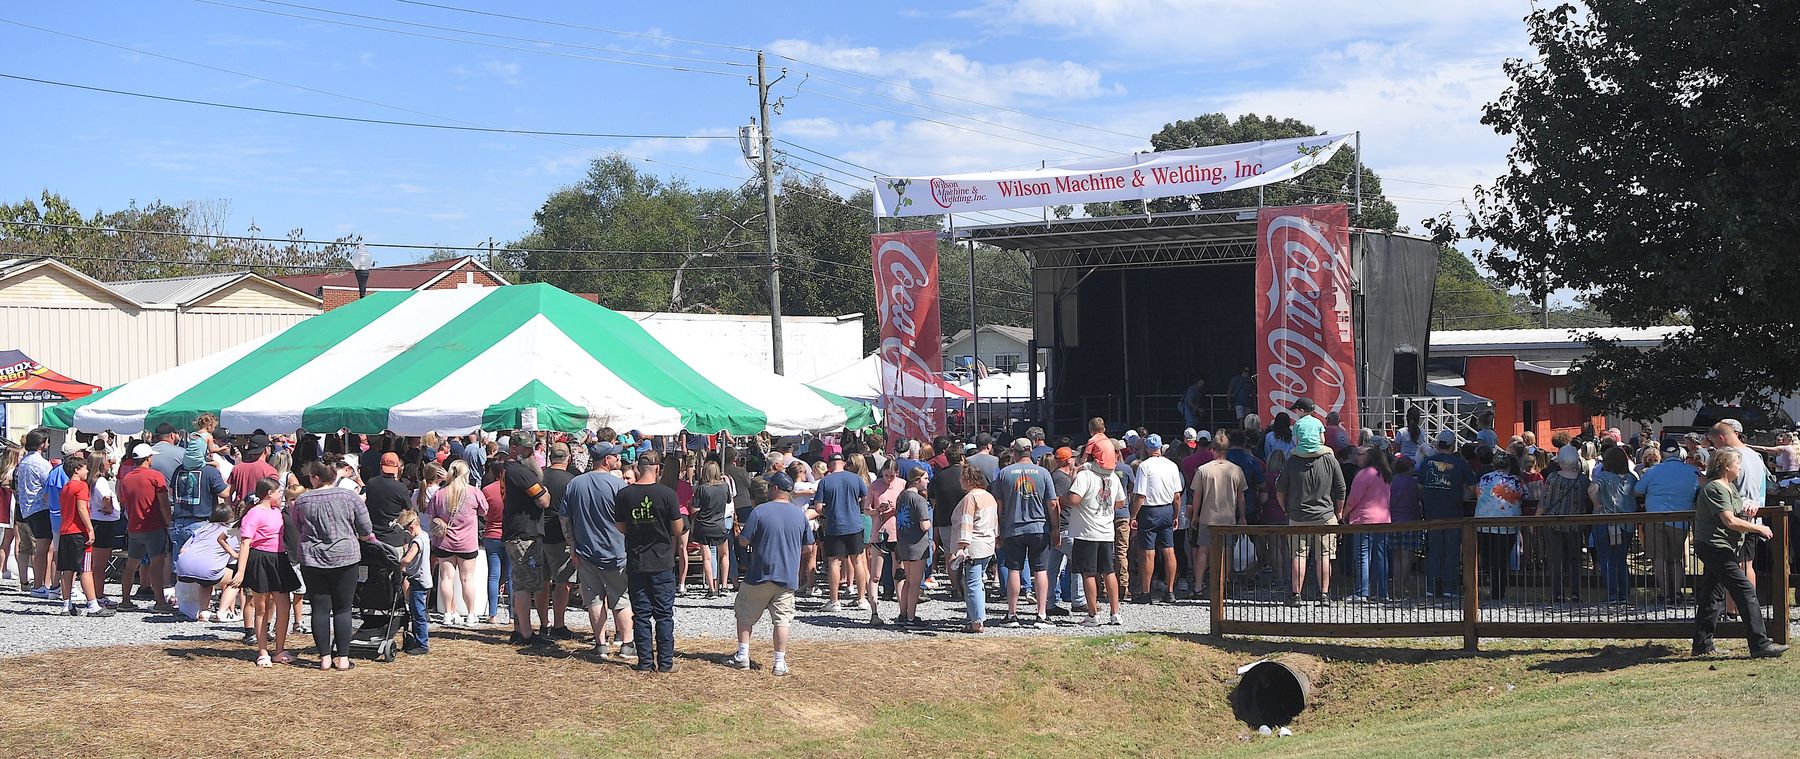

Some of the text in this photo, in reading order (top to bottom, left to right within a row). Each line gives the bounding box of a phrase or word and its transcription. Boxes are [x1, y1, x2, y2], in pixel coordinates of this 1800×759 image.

[997, 160, 1266, 198] Wilson Machine & Welding, Inc.
[933, 181, 959, 189] Wilson
[936, 187, 970, 196] Machine
[631, 508, 654, 520] GFL
